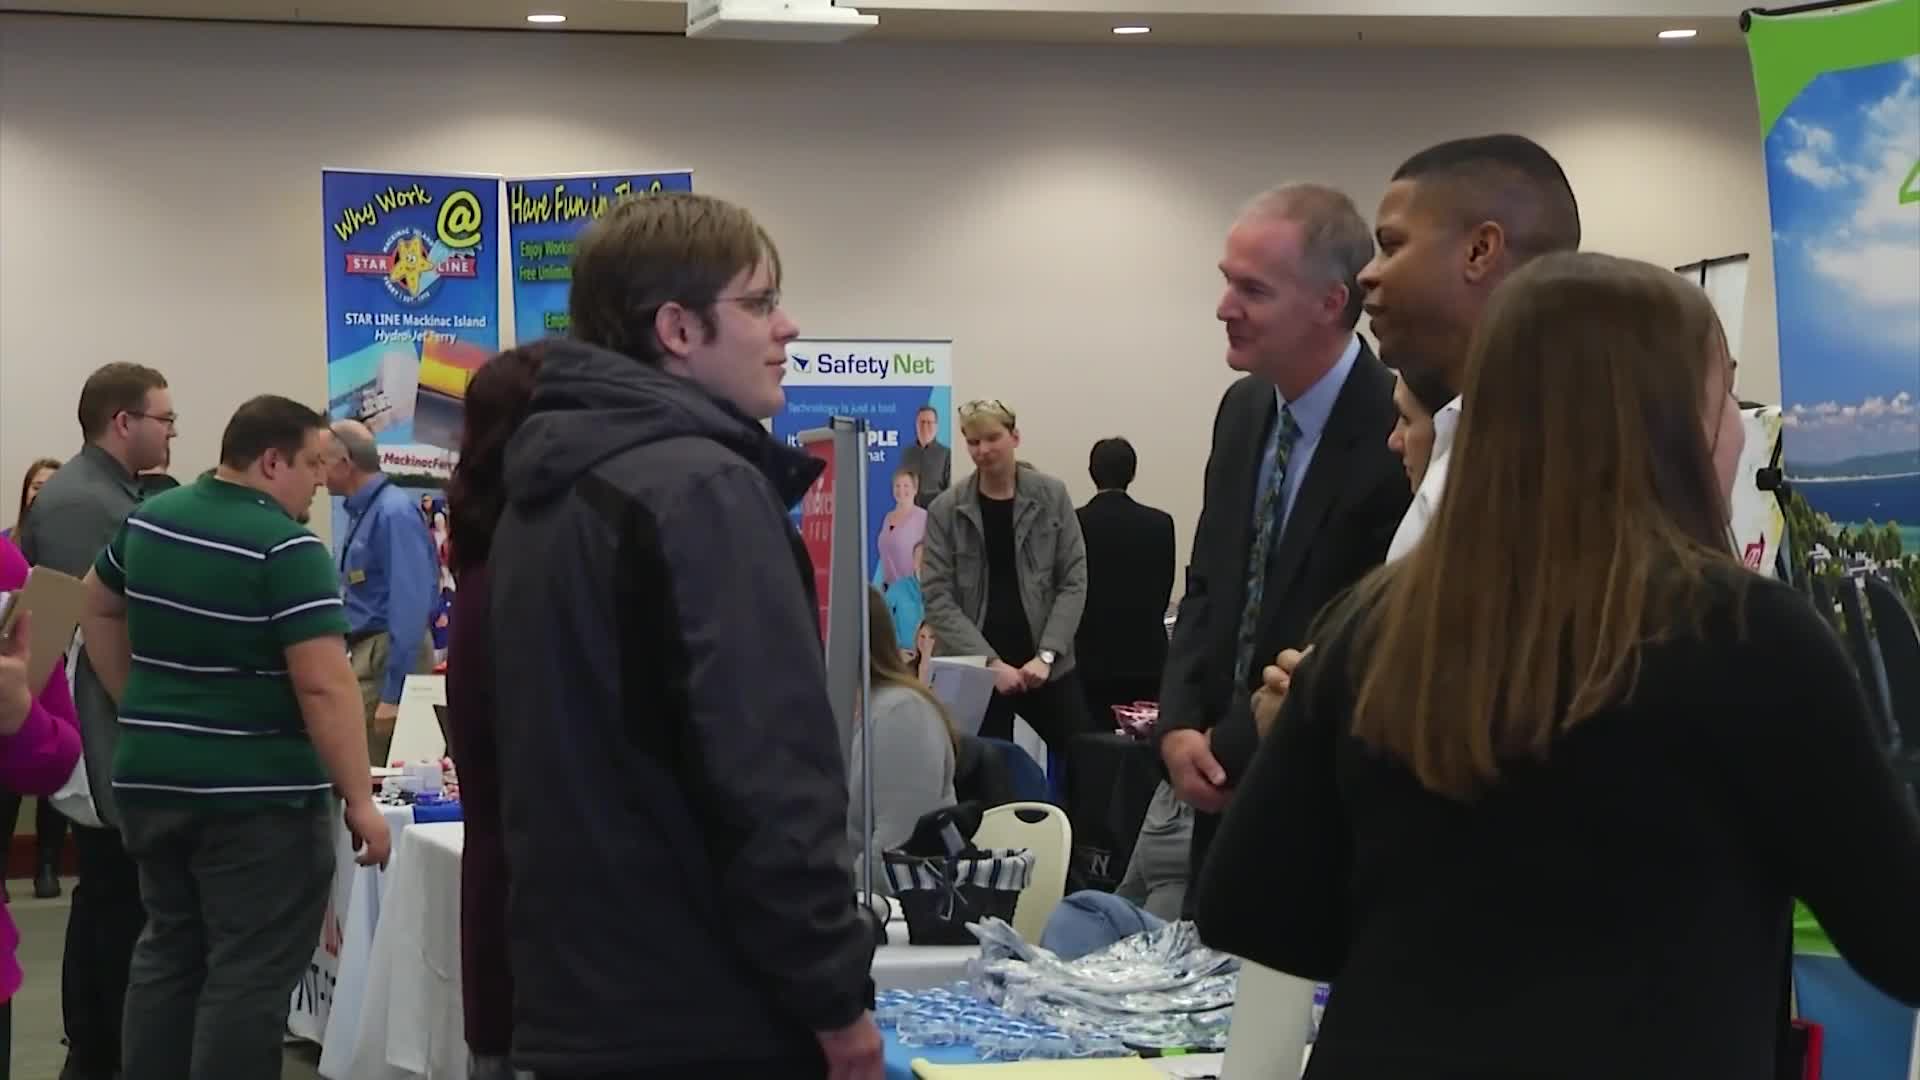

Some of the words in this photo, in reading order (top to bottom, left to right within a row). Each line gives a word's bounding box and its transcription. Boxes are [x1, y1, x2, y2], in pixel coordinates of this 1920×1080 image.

[511, 184, 551, 224] Have
[555, 184, 588, 223] Fun
[334, 203, 376, 241] Why
[375, 184, 432, 213] Work
[437, 190, 482, 248] @
[353, 258, 387, 270] STAR
[438, 261, 469, 273] LINE
[345, 313, 373, 325] STAR
[375, 313, 401, 326] LINE
[402, 314, 451, 327] Mackinac
[453, 316, 487, 328] Island
[427, 331, 457, 344] Ferry
